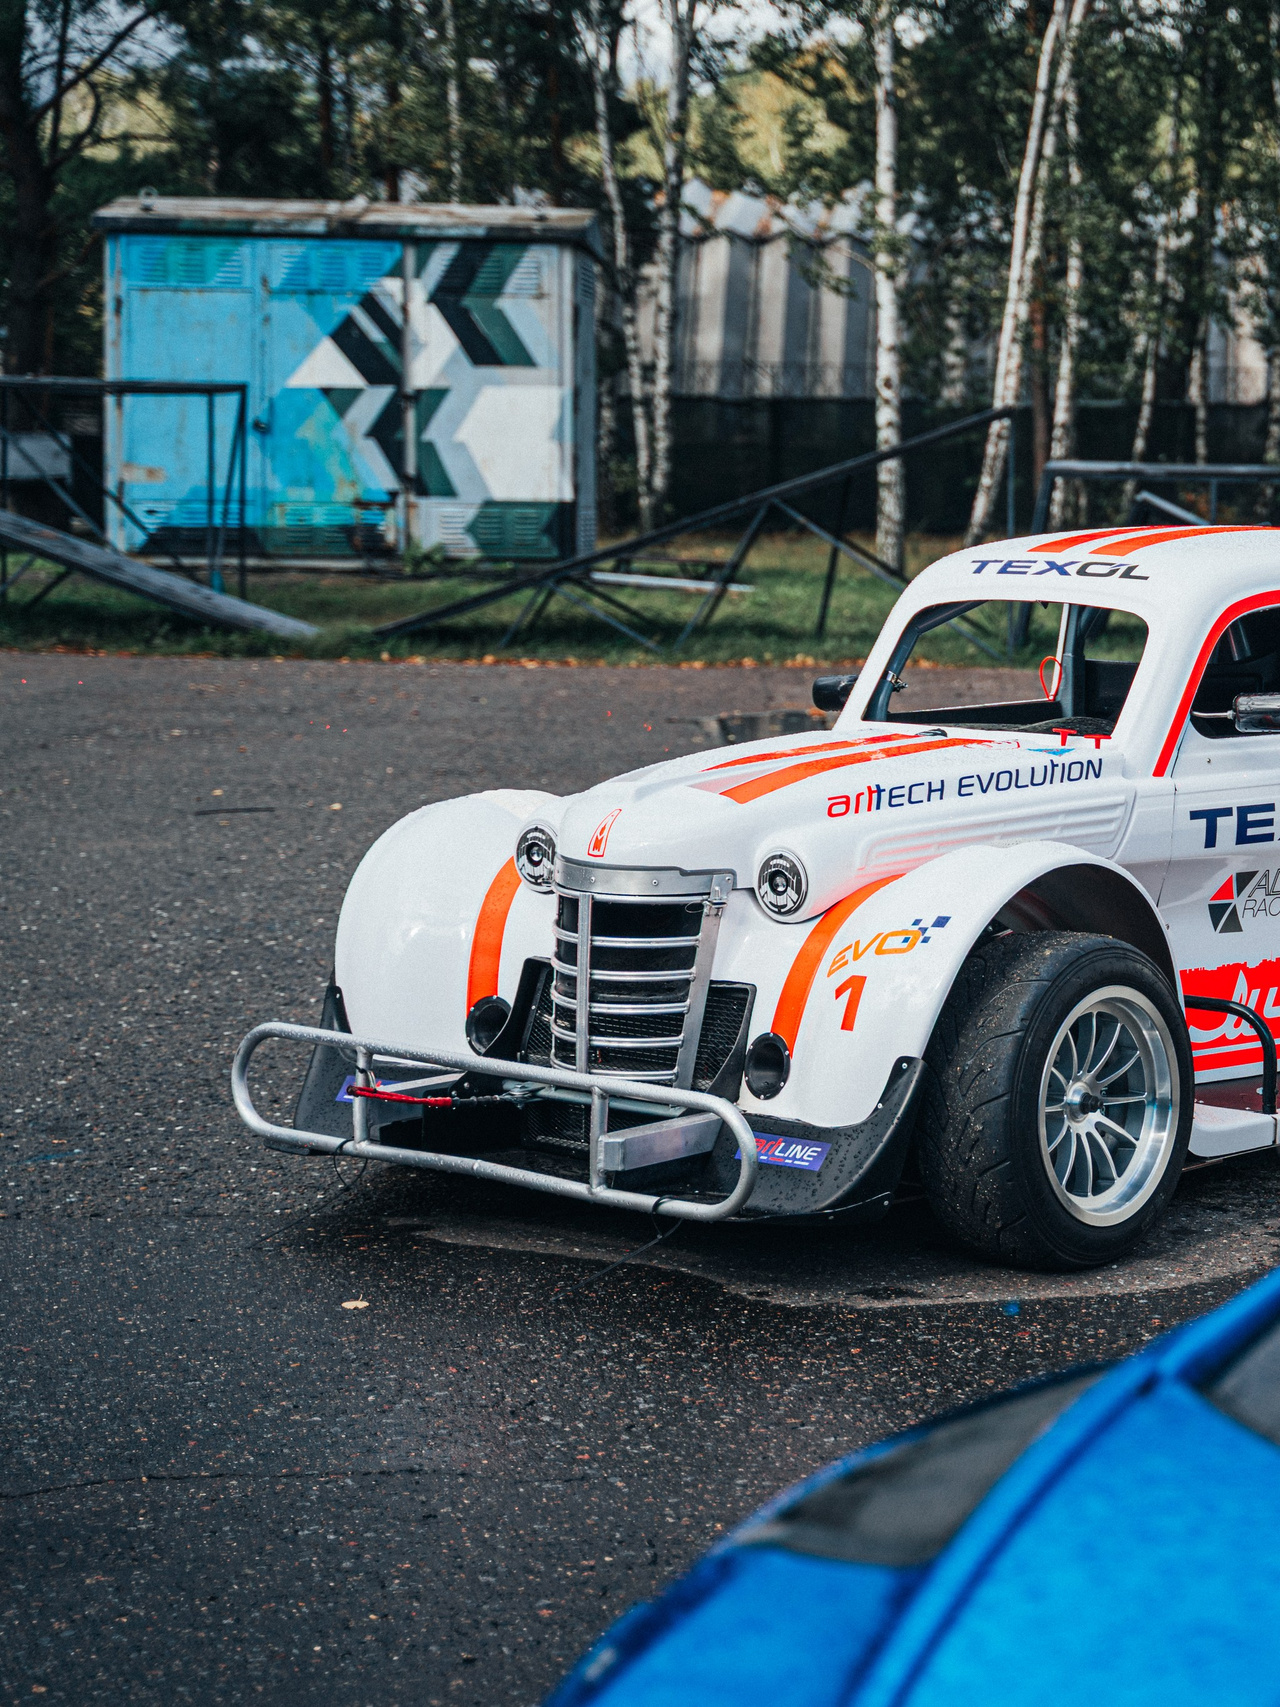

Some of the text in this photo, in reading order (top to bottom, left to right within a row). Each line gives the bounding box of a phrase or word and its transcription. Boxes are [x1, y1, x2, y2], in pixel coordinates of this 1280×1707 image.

[970, 558, 1150, 581] TEXOL
[827, 929, 923, 978] EVO
[835, 974, 867, 1032] 1
